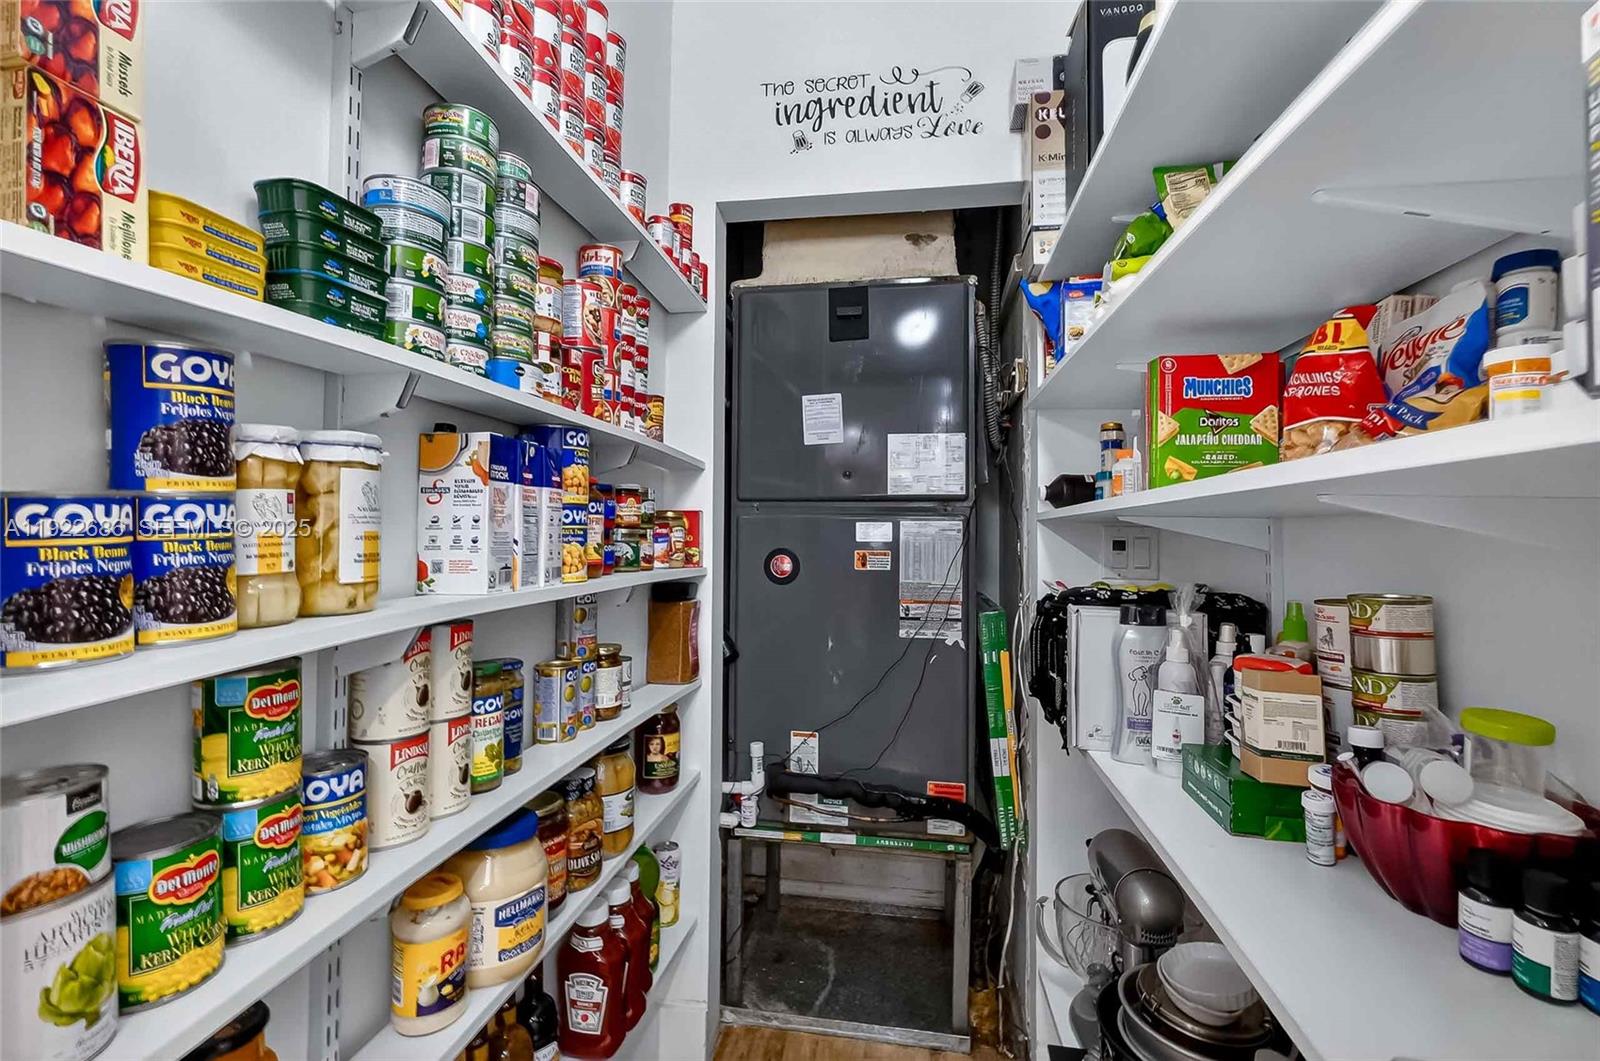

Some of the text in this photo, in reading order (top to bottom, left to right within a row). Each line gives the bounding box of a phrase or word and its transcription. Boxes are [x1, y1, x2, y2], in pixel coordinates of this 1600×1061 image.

[117, 50, 133, 98] Mussels
[760, 80, 795, 97] The
[775, 80, 944, 132] ingredient
[916, 114, 984, 138] Love
[109, 118, 136, 195] IBERIA
[120, 210, 136, 261] Mejillone
[1184, 376, 1253, 399] MUNCHIES
[1291, 371, 1341, 386] CKLINGS
[171, 390, 209, 405] Black
[160, 402, 212, 418] Frijoles
[1396, 405, 1425, 424] Pack
[1200, 416, 1239, 427] Doritos
[1175, 431, 1263, 446] JALAPEÑO CHEDDAR
[14, 502, 135, 538] GOYA
[561, 508, 588, 524] OYA
[38, 546, 128, 562] Black Beans
[162, 541, 202, 555] Black
[152, 552, 206, 568] Frijoles
[25, 562, 93, 578] Frijoles
[251, 695, 272, 709] Del
[306, 768, 364, 803] OYA
[61, 824, 107, 856] MUSHROOM
[259, 826, 279, 841] Del
[156, 859, 218, 895] Del Monte
[166, 917, 213, 946] WHOLE
[140, 941, 195, 969] KERNEL
